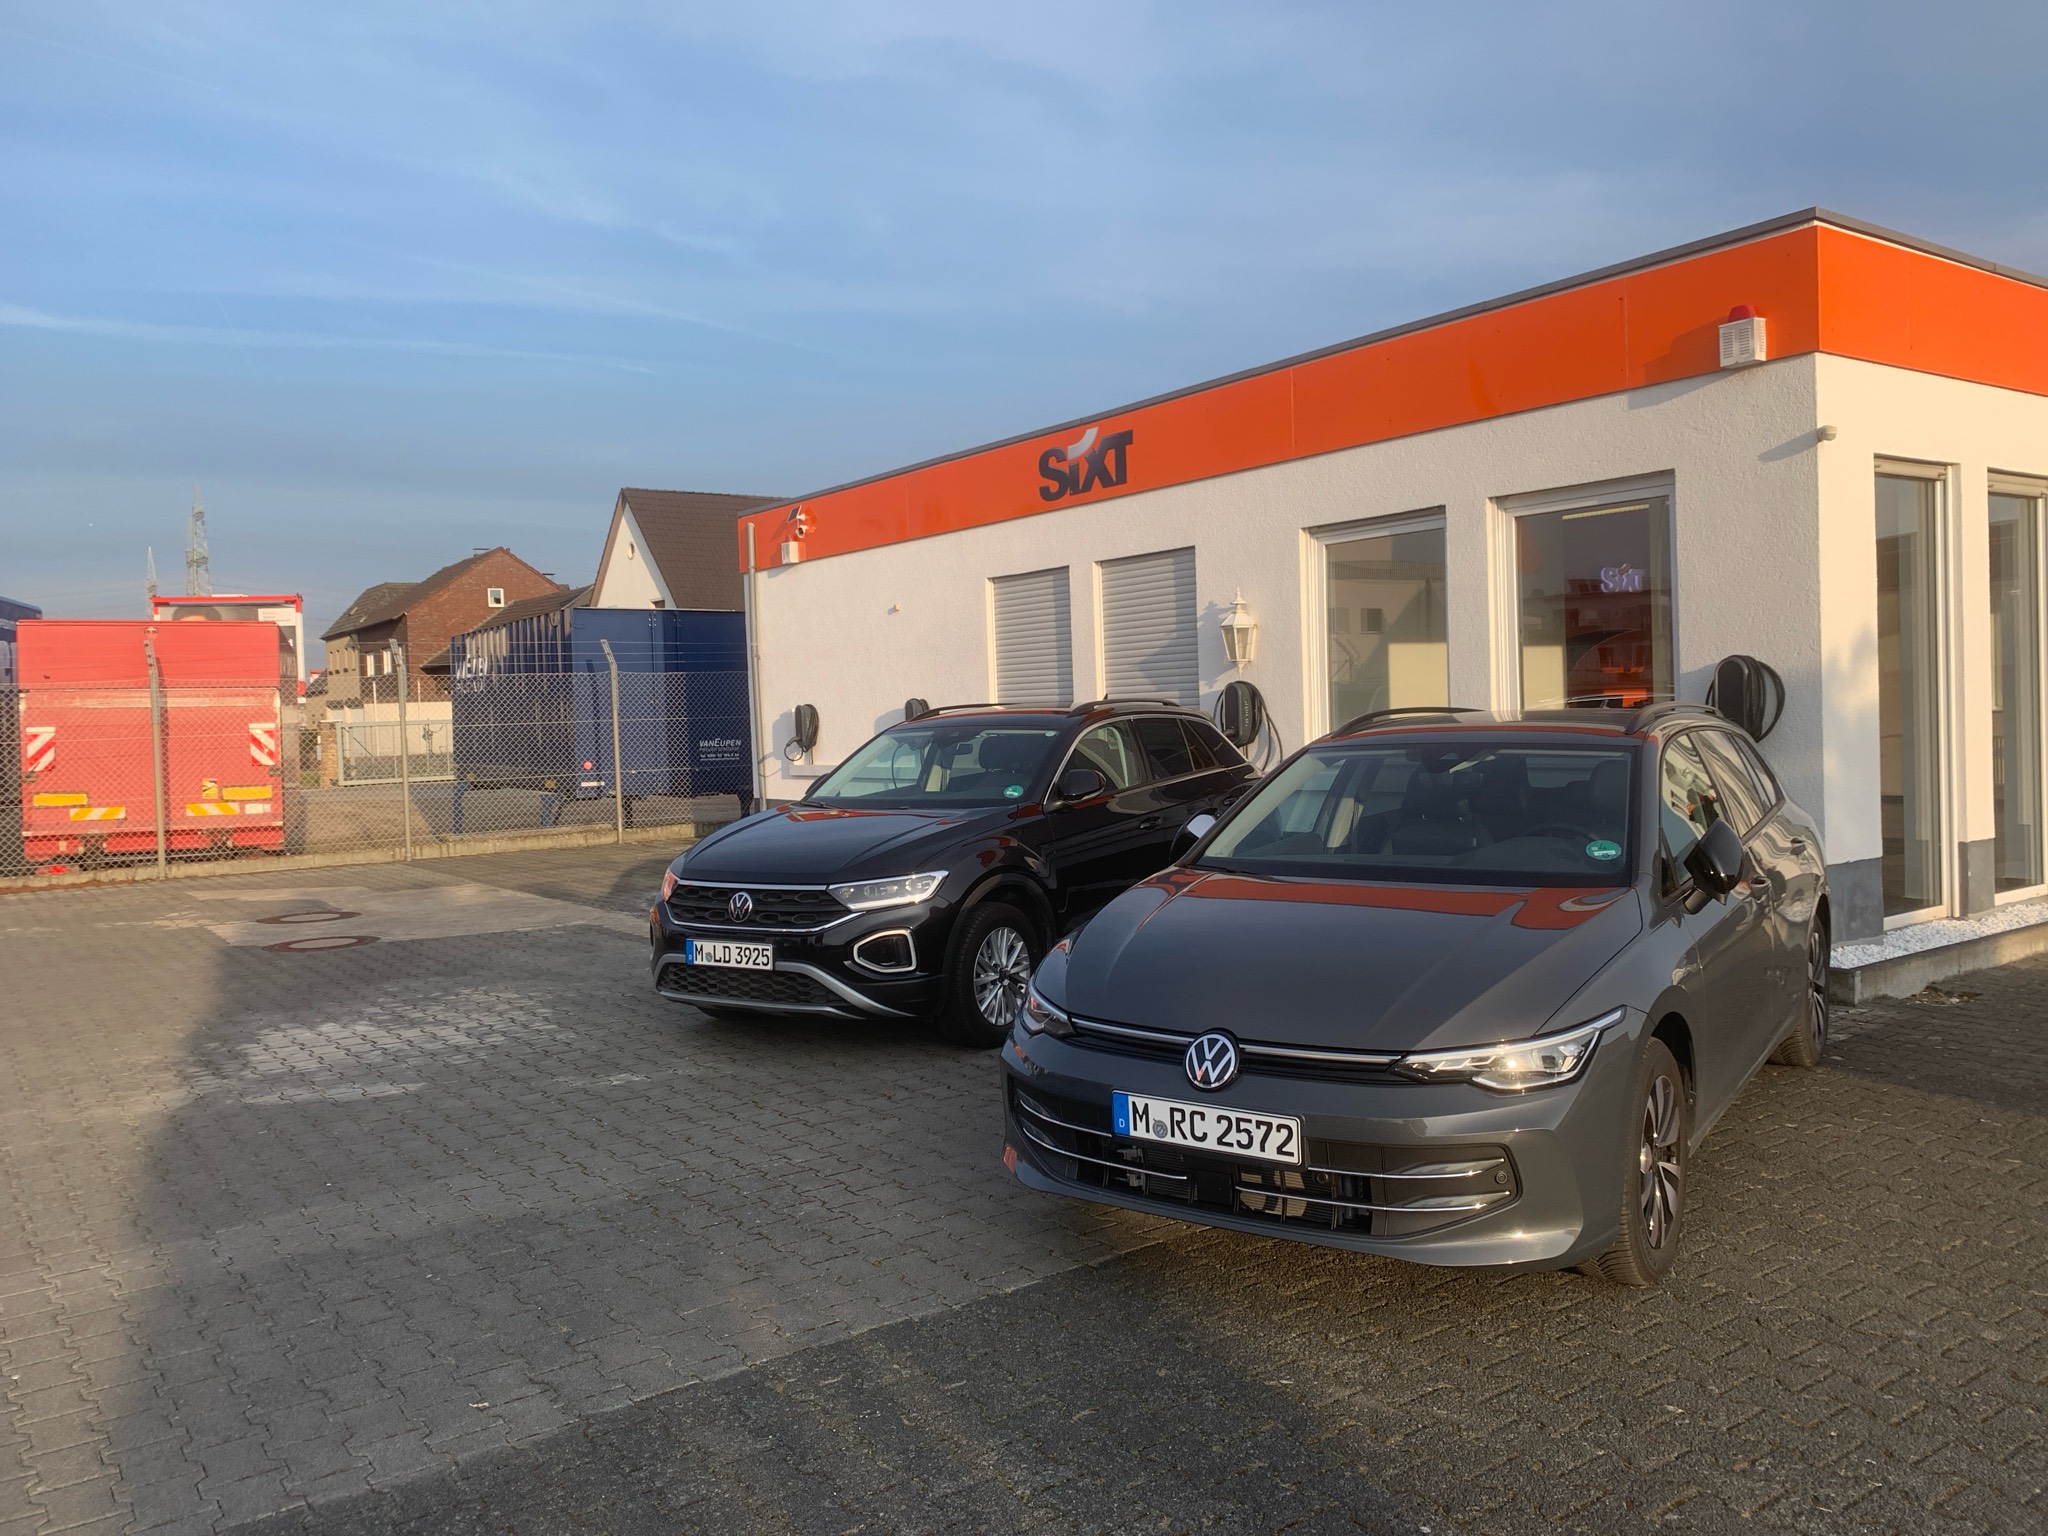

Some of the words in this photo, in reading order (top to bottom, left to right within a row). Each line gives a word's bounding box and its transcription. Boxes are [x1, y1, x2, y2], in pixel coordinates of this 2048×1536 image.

[695, 944, 703, 962] M
[713, 945, 731, 963] LD
[735, 946, 770, 966] 3925
[1131, 1100, 1150, 1134] M
[1169, 1106, 1208, 1143] RC
[1215, 1114, 1295, 1158] 2572
